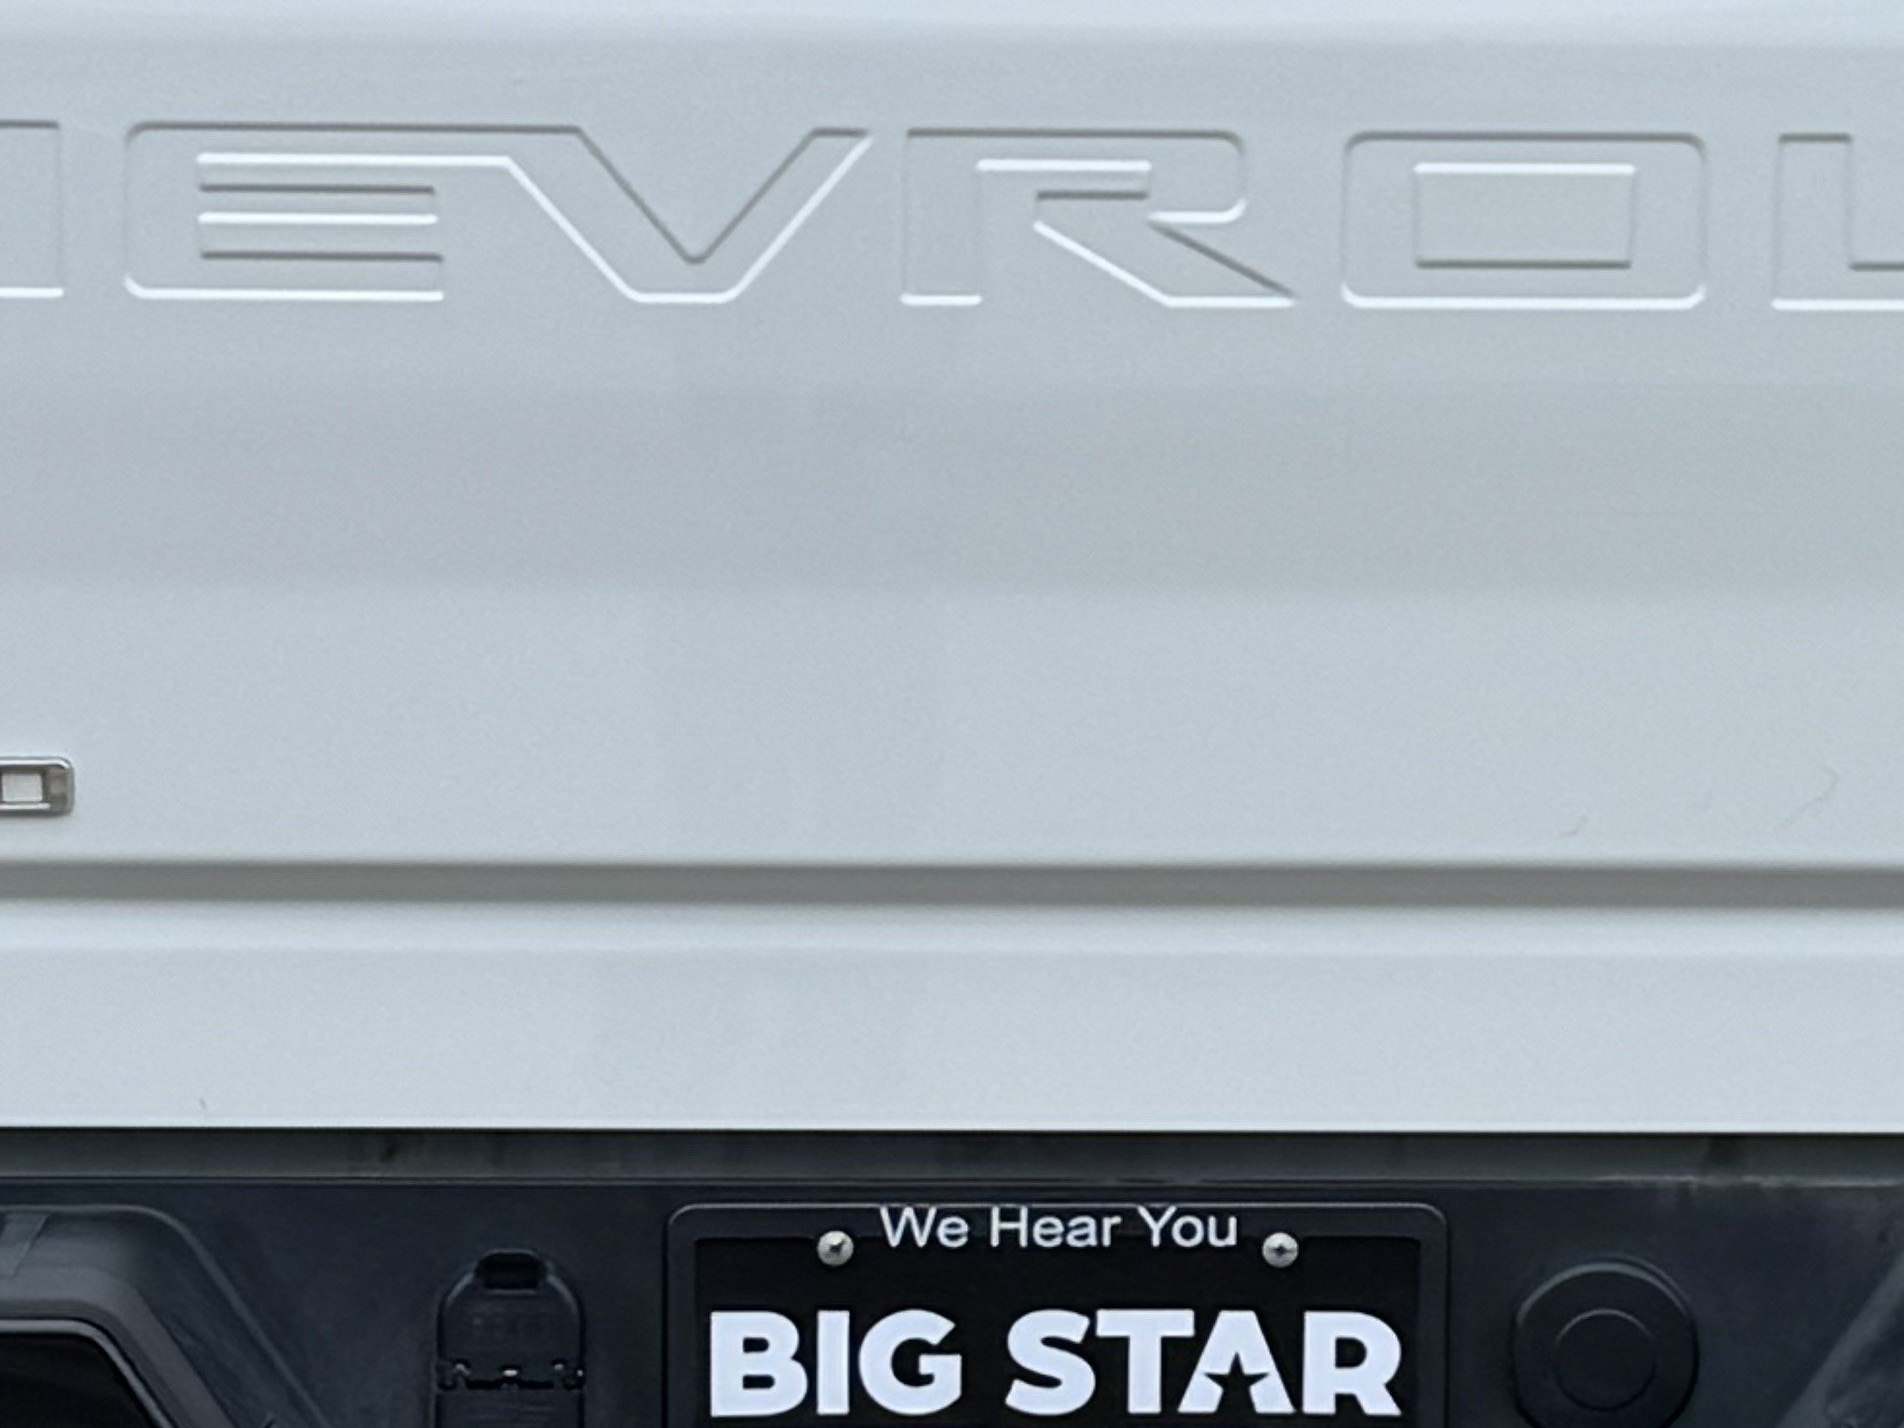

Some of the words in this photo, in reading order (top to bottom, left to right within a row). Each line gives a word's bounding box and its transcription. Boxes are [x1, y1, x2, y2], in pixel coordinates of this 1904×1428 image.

[880, 1209, 968, 1247] We
[991, 1209, 1121, 1247] Hear
[1138, 1209, 1236, 1247] You
[711, 1310, 961, 1417] BIG
[1006, 1309, 1401, 1415] STAR
